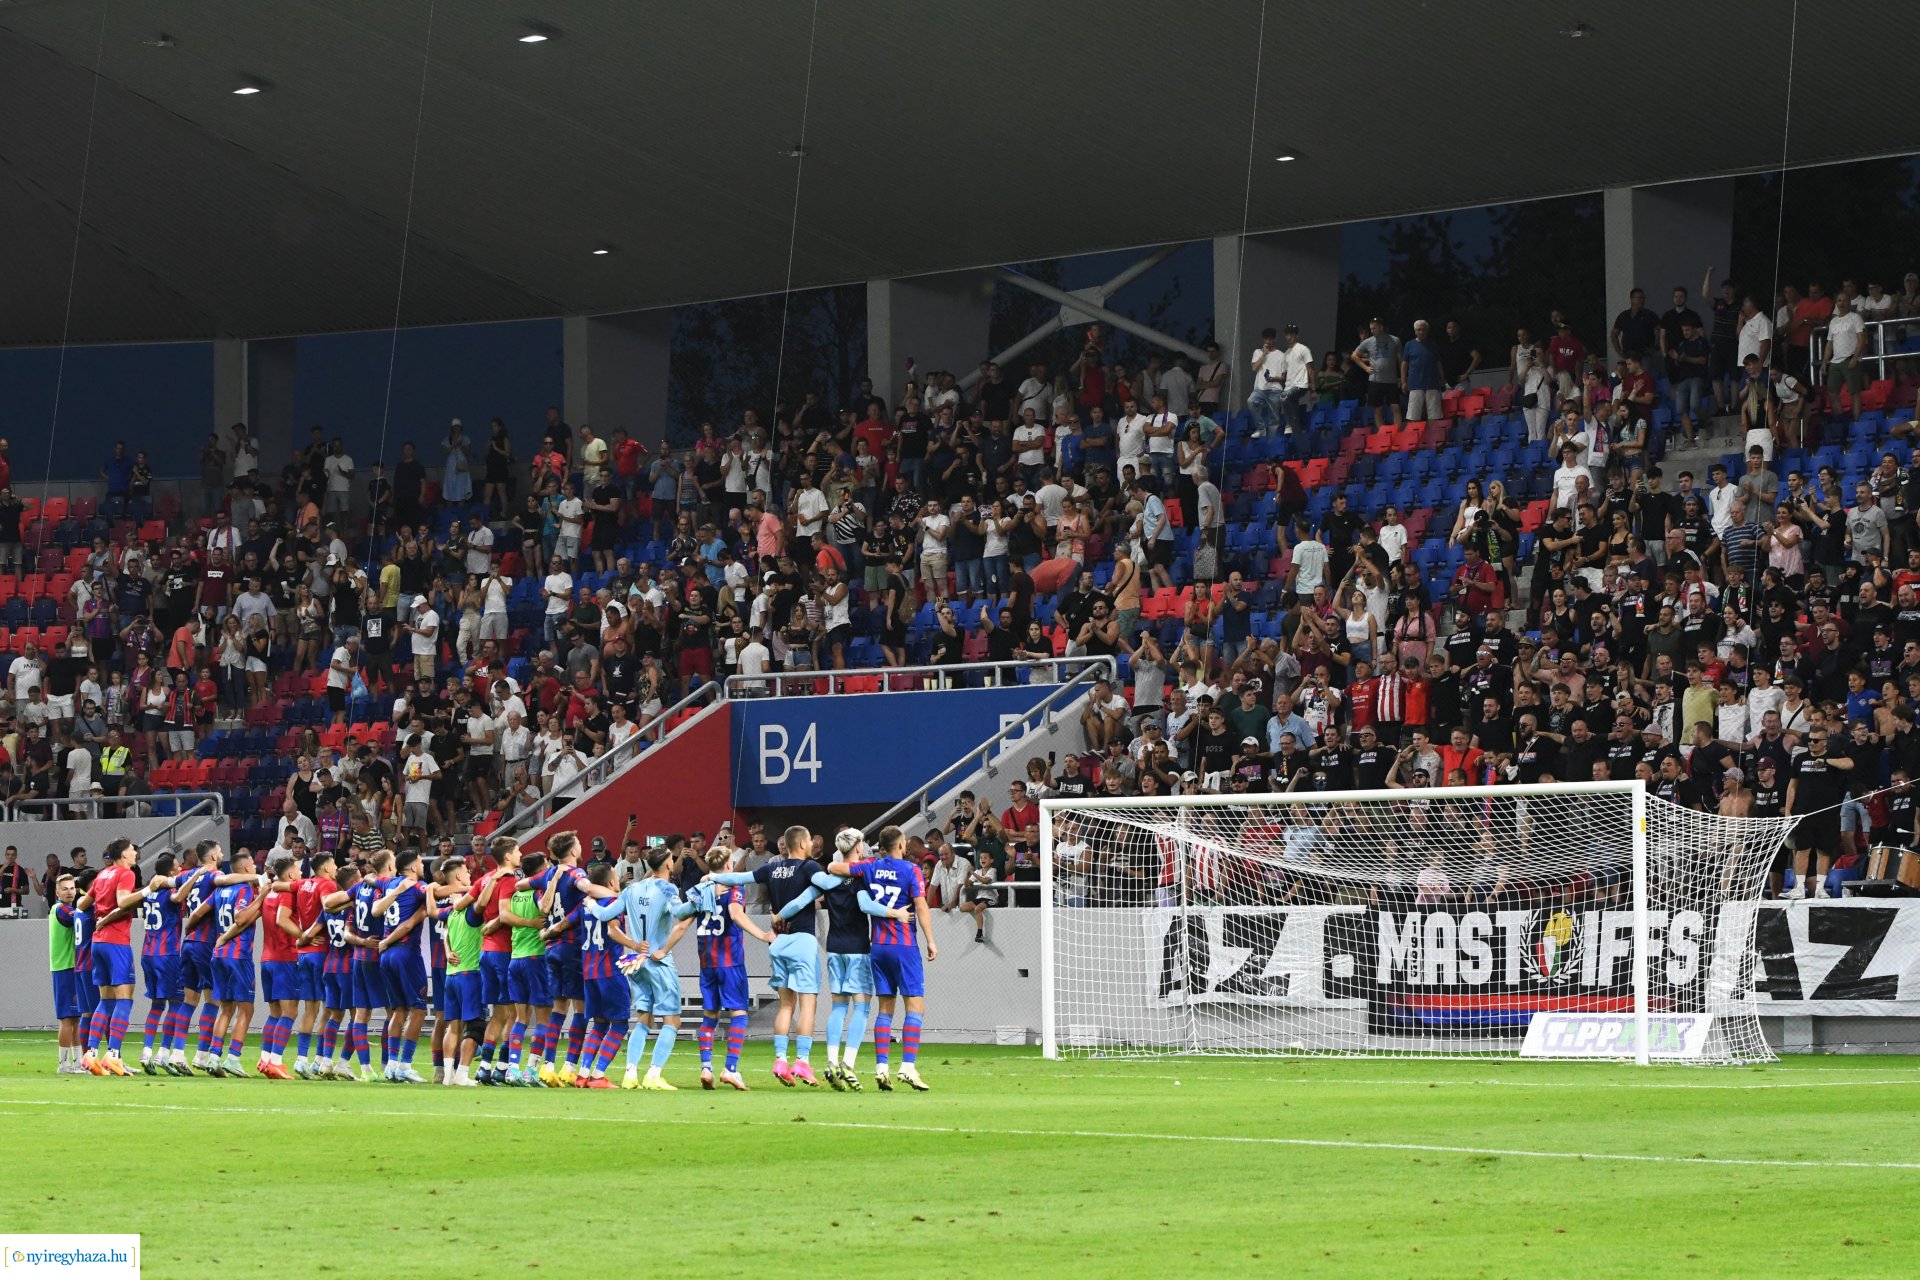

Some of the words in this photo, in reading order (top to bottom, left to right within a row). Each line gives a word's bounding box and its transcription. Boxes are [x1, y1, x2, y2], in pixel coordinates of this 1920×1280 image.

[1724, 439, 1734, 447] 15
[759, 722, 822, 785] B4
[874, 869, 898, 881] EPPEL
[869, 883, 902, 909] 27
[143, 902, 163, 931] 25
[639, 913, 647, 942] 1
